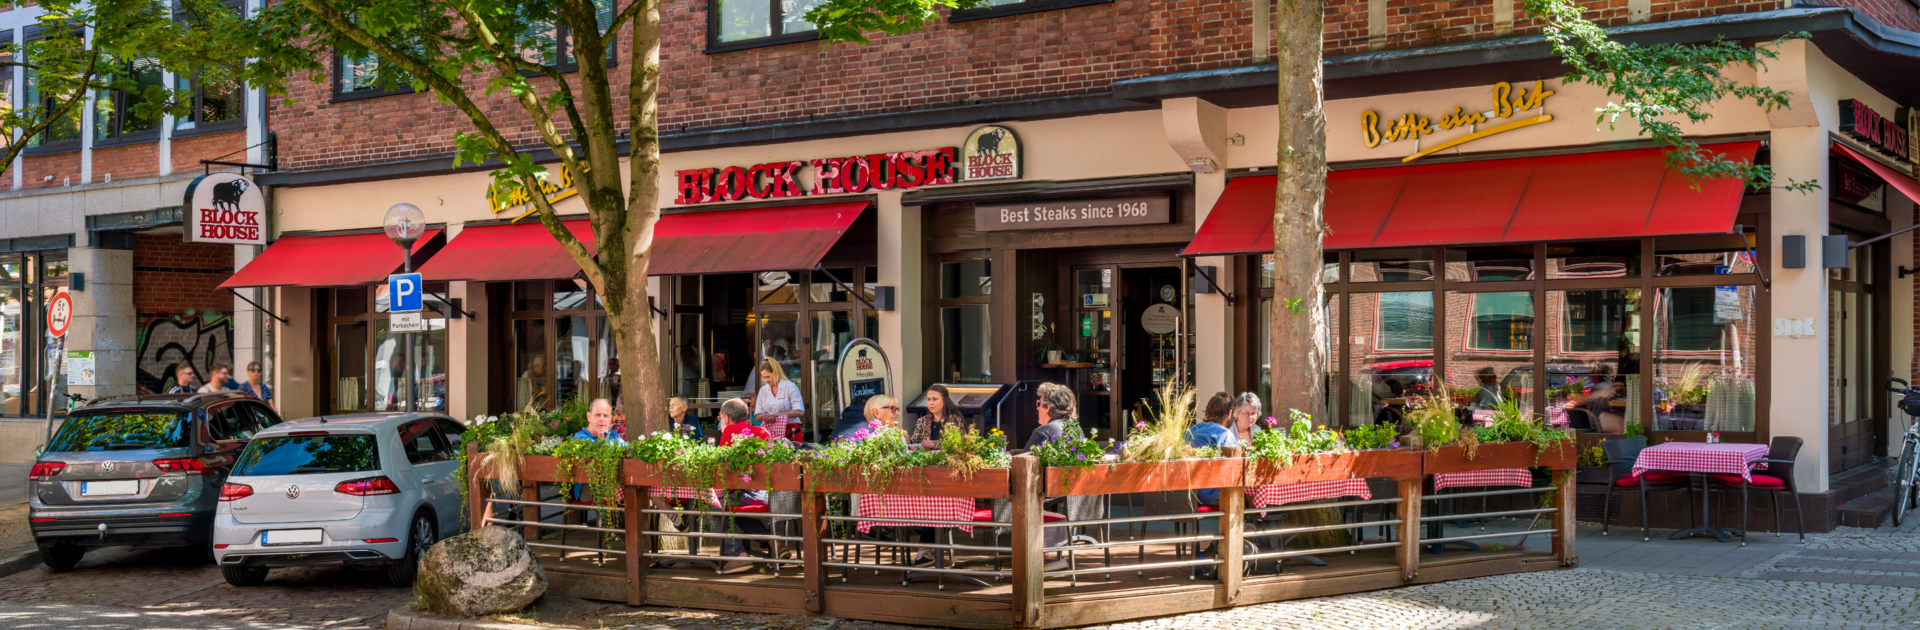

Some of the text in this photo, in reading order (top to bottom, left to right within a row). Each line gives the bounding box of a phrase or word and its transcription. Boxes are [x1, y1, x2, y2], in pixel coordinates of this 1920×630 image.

[1361, 79, 1555, 149] Bitte ein Bit
[1853, 98, 1881, 145] BLOCK
[1883, 116, 1907, 159] HOUSE
[968, 153, 1012, 167] BLOCK
[968, 165, 1012, 178] HOUSE
[674, 146, 957, 205] BLOCK HOUSE
[489, 186, 530, 214] Btte
[200, 209, 259, 226] BLOCK
[1000, 202, 1148, 223] Best Steaks since 1968
[200, 224, 259, 240] HOUSE
[397, 279, 414, 307] P
